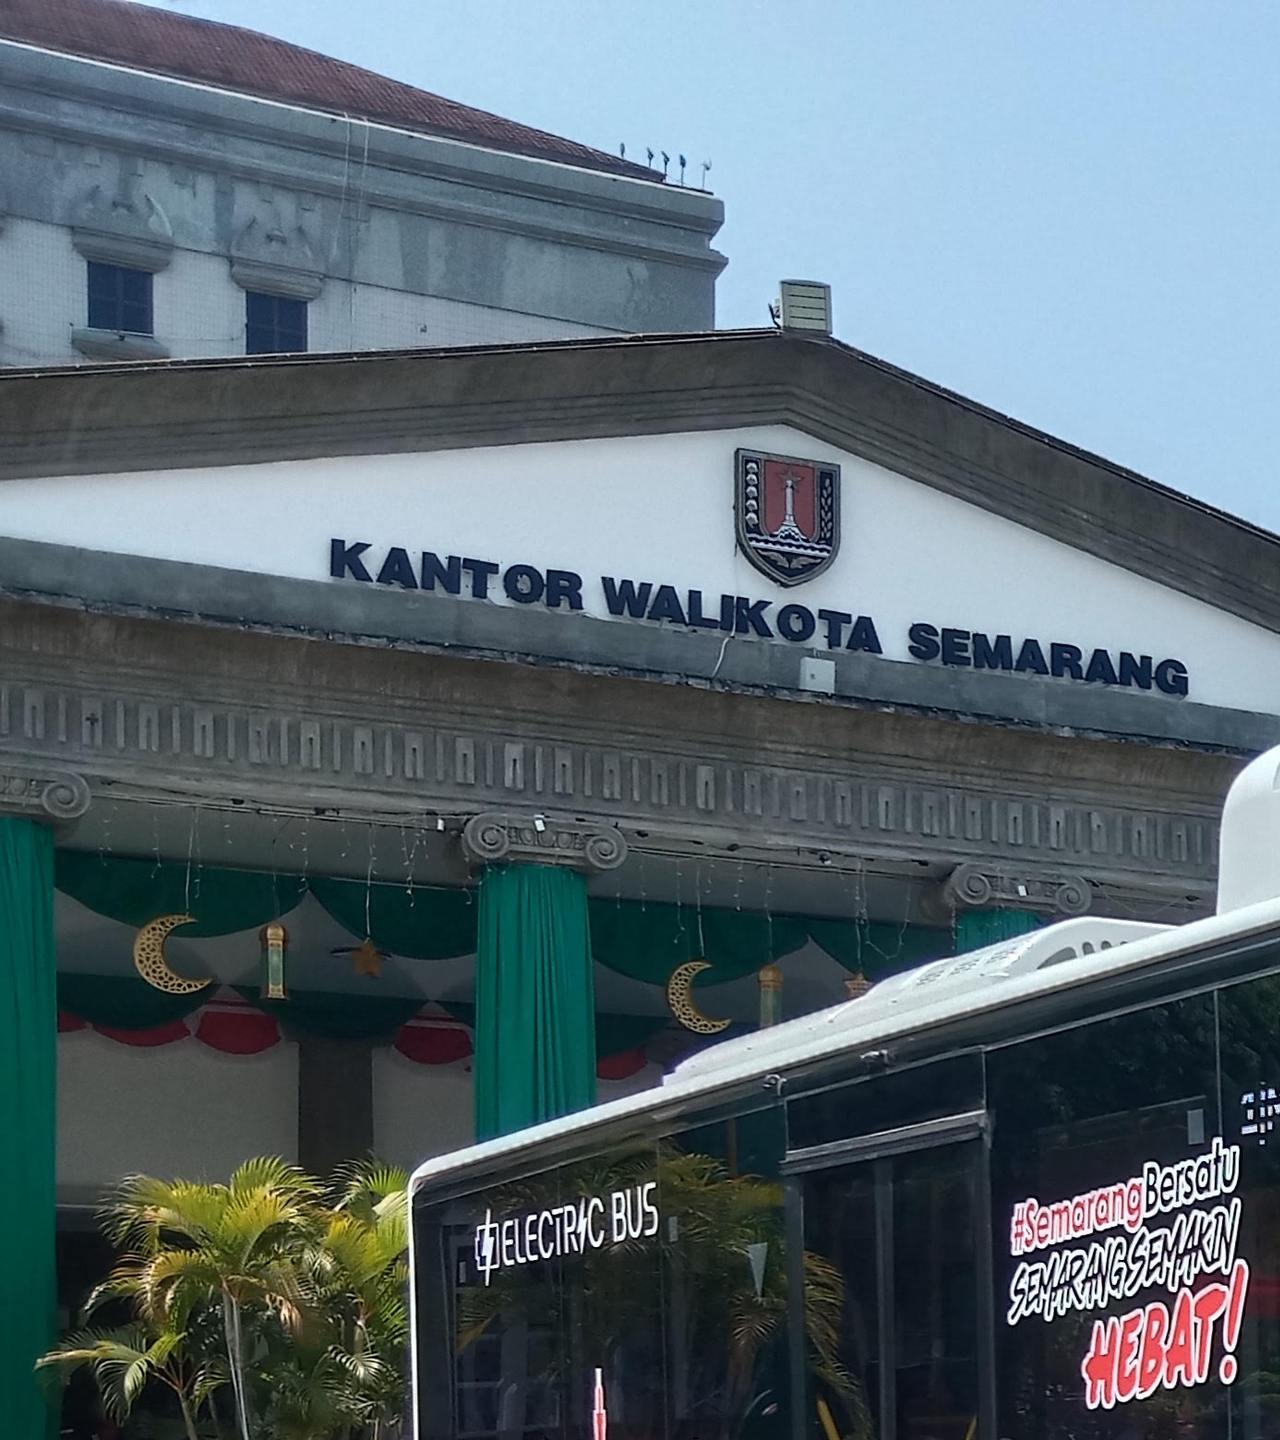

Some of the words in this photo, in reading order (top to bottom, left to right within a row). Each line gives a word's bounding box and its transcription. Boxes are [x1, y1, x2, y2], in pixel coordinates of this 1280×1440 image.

[329, 537, 584, 610] KANTOR
[601, 576, 883, 655] WALIKOTA
[907, 622, 1190, 696] SEMARANG
[502, 1196, 605, 1267] ELECTRIC
[610, 1181, 660, 1243] BUS
[1011, 1135, 1241, 1256] #SemarangBersatu
[1007, 1235, 1127, 1325] SEMARANG
[1124, 1198, 1242, 1296] SEMAKIN
[1081, 1259, 1250, 1410] HEBAT!
